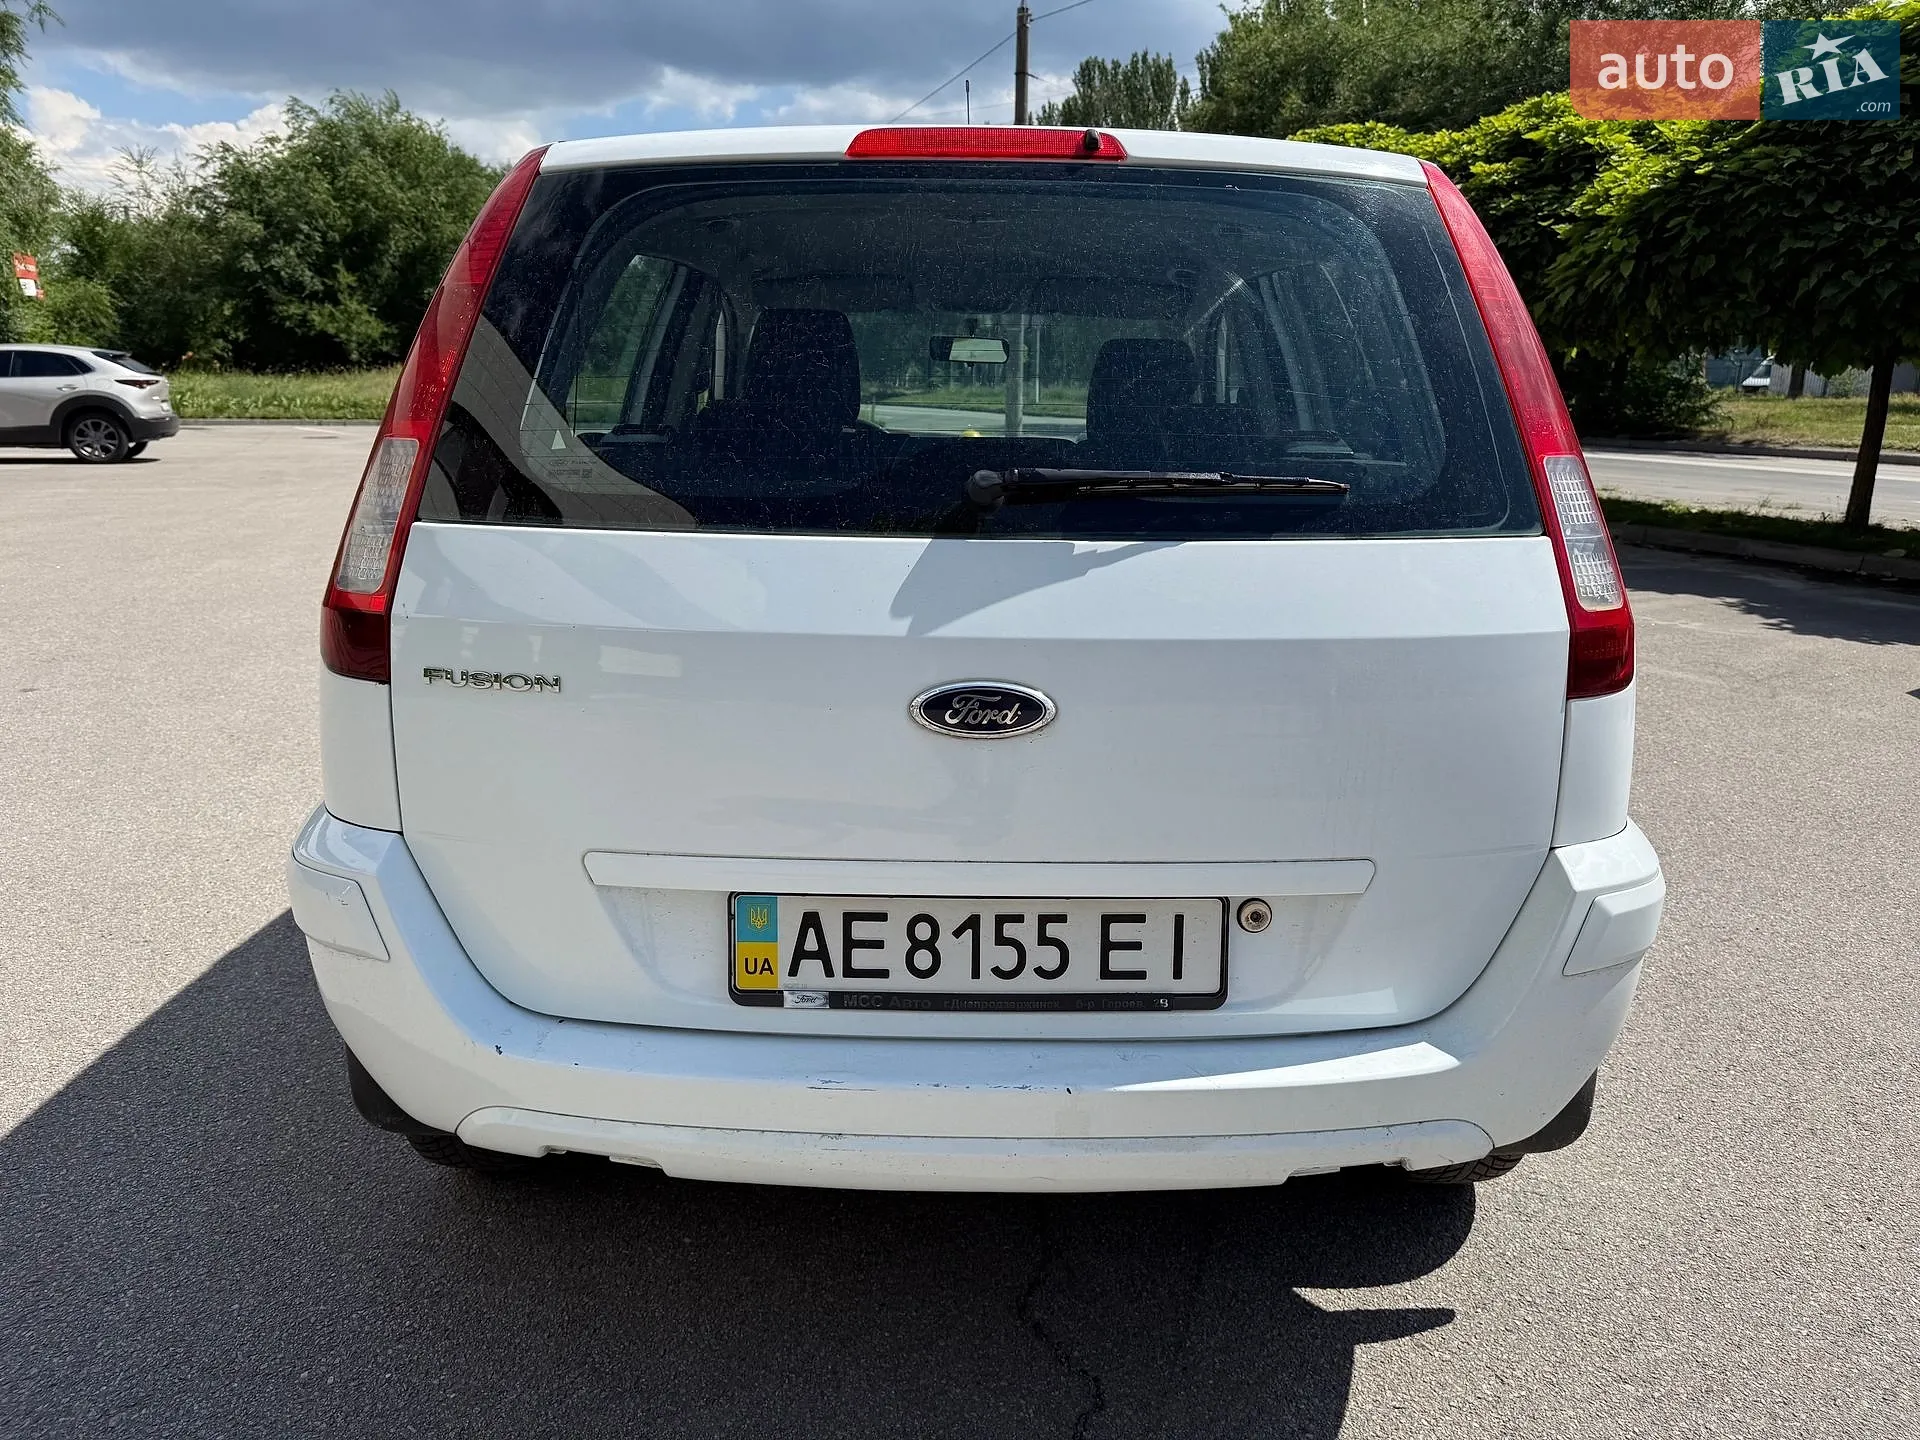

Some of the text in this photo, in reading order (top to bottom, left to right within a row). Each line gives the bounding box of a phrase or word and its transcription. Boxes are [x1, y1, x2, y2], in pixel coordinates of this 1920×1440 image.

[423, 667, 561, 693] FUSION
[944, 694, 1021, 725] Ford
[744, 957, 775, 975] UA
